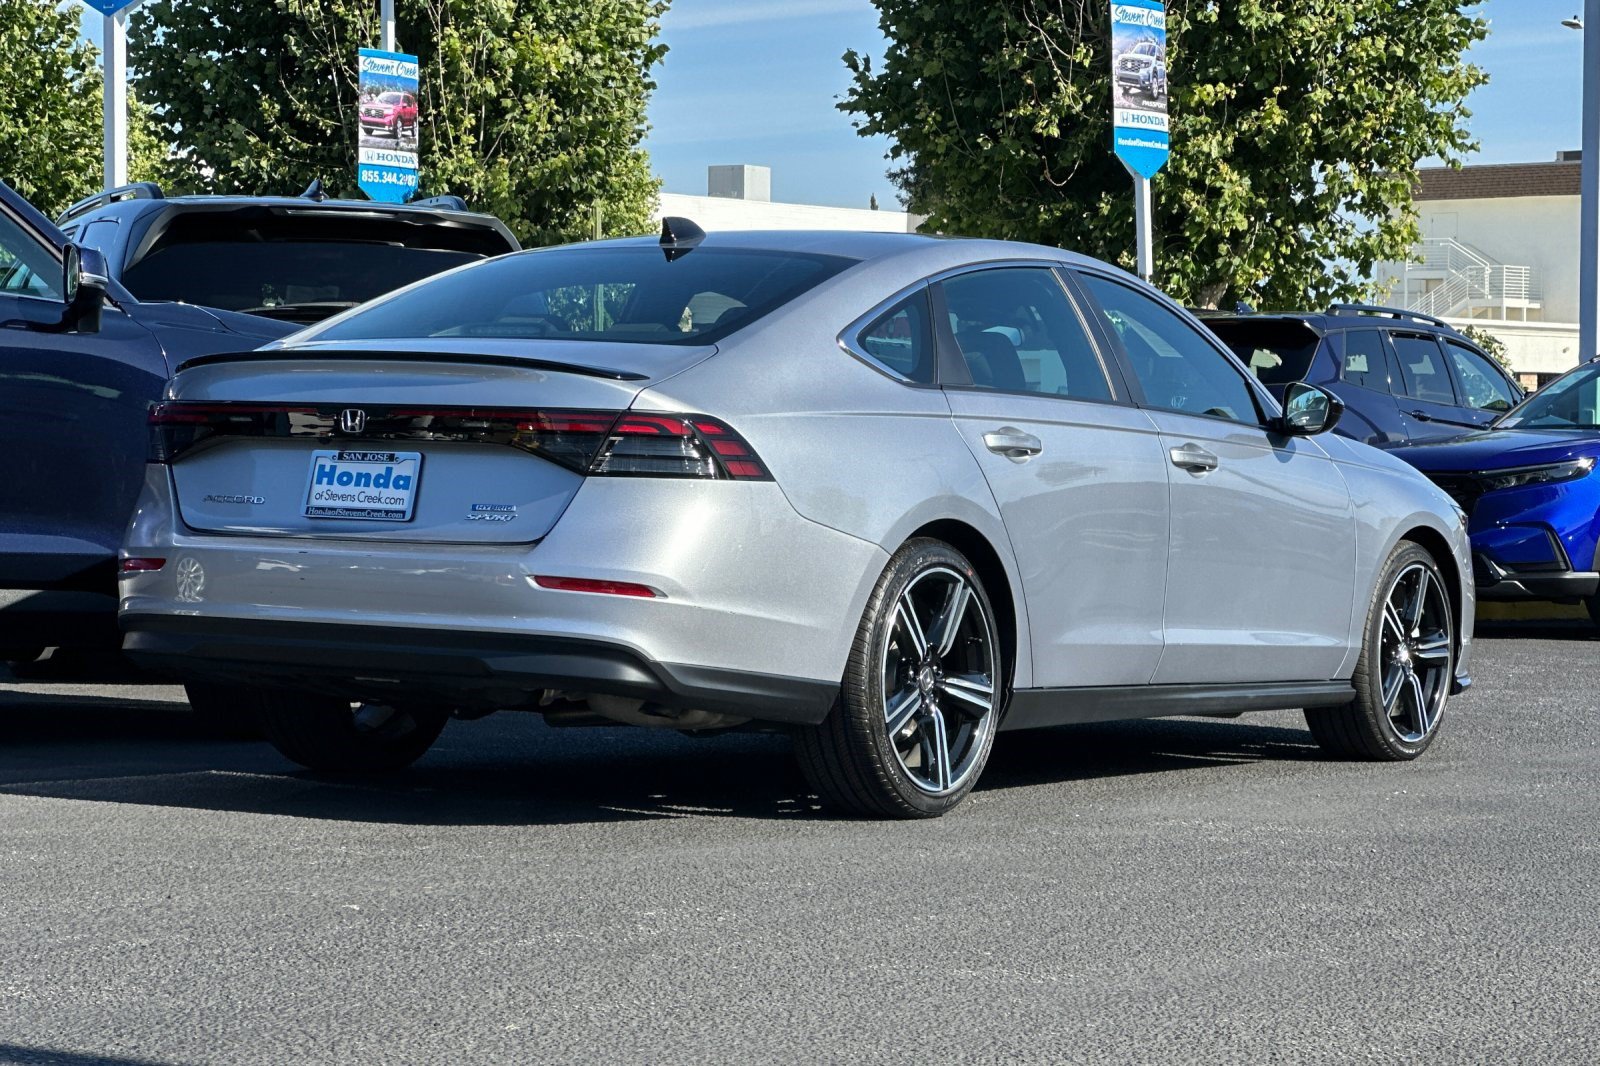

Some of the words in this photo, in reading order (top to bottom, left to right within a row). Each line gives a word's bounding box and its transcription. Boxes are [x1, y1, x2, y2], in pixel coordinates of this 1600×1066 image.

[1113, 5, 1145, 25] Stevens
[1147, 9, 1164, 27] Creek
[362, 57, 394, 75] Stevens
[396, 61, 417, 77] Creek
[1131, 113, 1165, 126] HONDA
[376, 152, 415, 164] HONDA
[342, 452, 362, 461] SAN
[365, 453, 390, 462] JOSE
[315, 464, 411, 491] Honda
[203, 495, 265, 504] ACCORD
[314, 491, 324, 501] of
[325, 489, 356, 503] Stevens
[357, 491, 404, 506] Creek.com
